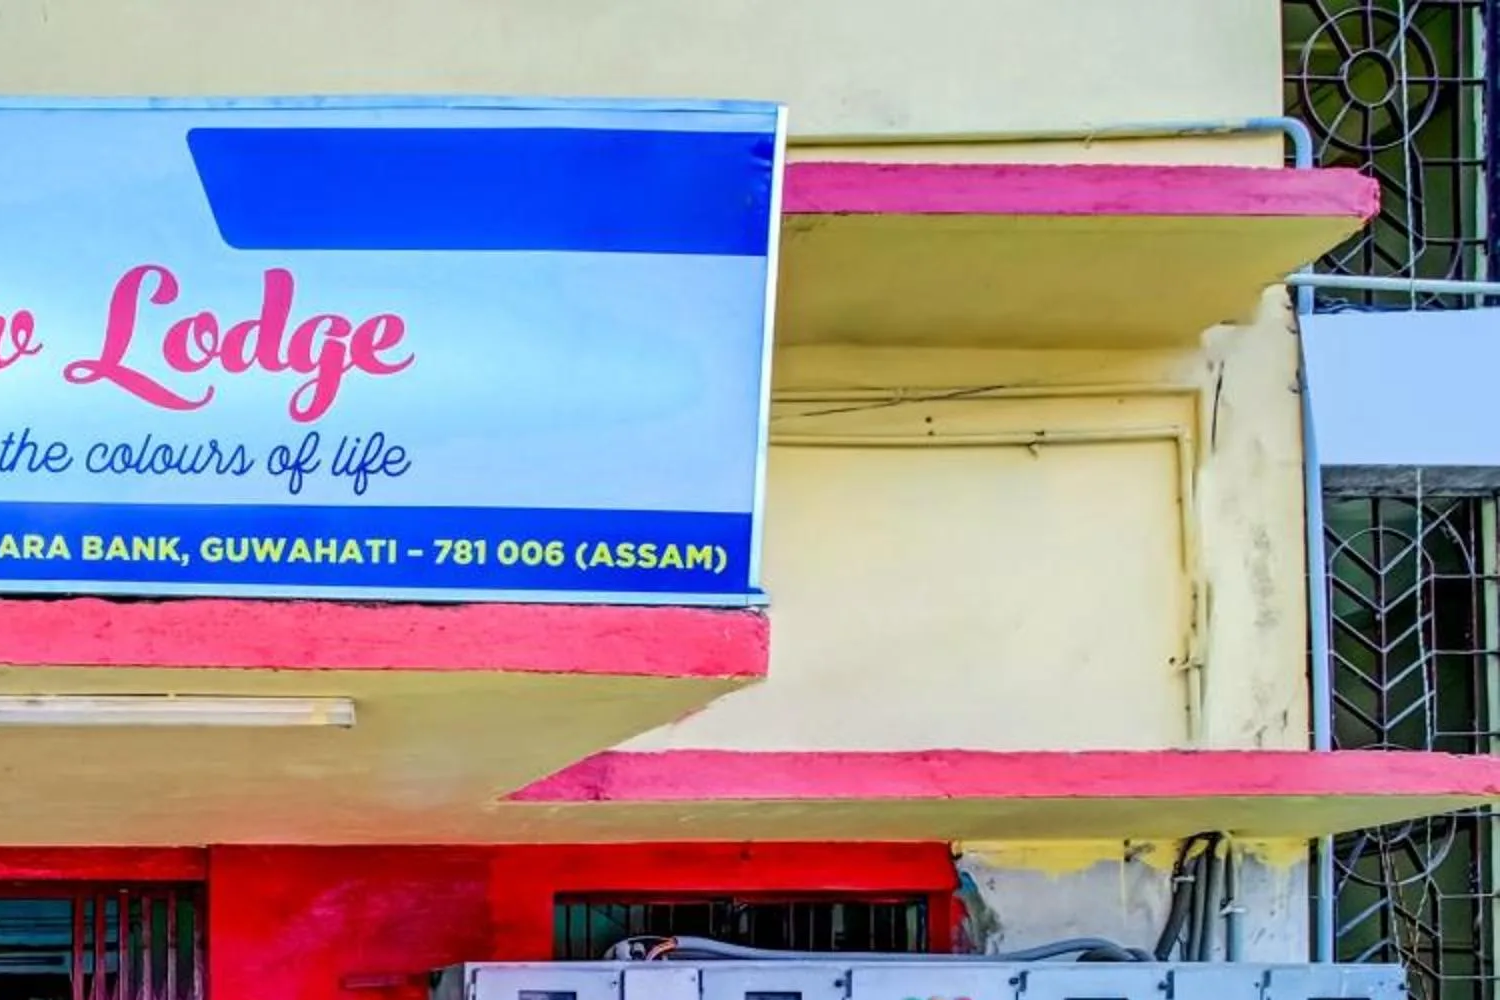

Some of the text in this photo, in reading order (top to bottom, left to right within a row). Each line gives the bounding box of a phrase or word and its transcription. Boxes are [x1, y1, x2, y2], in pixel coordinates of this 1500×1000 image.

[63, 264, 414, 423] Lodge
[85, 433, 256, 476] colours
[267, 431, 322, 496] of
[331, 431, 413, 496] life
[82, 535, 190, 567] BANK,
[200, 536, 397, 564] GUWAHATI
[434, 539, 486, 565] 781
[497, 540, 565, 567] 006
[575, 542, 728, 574] (ASSAM)
